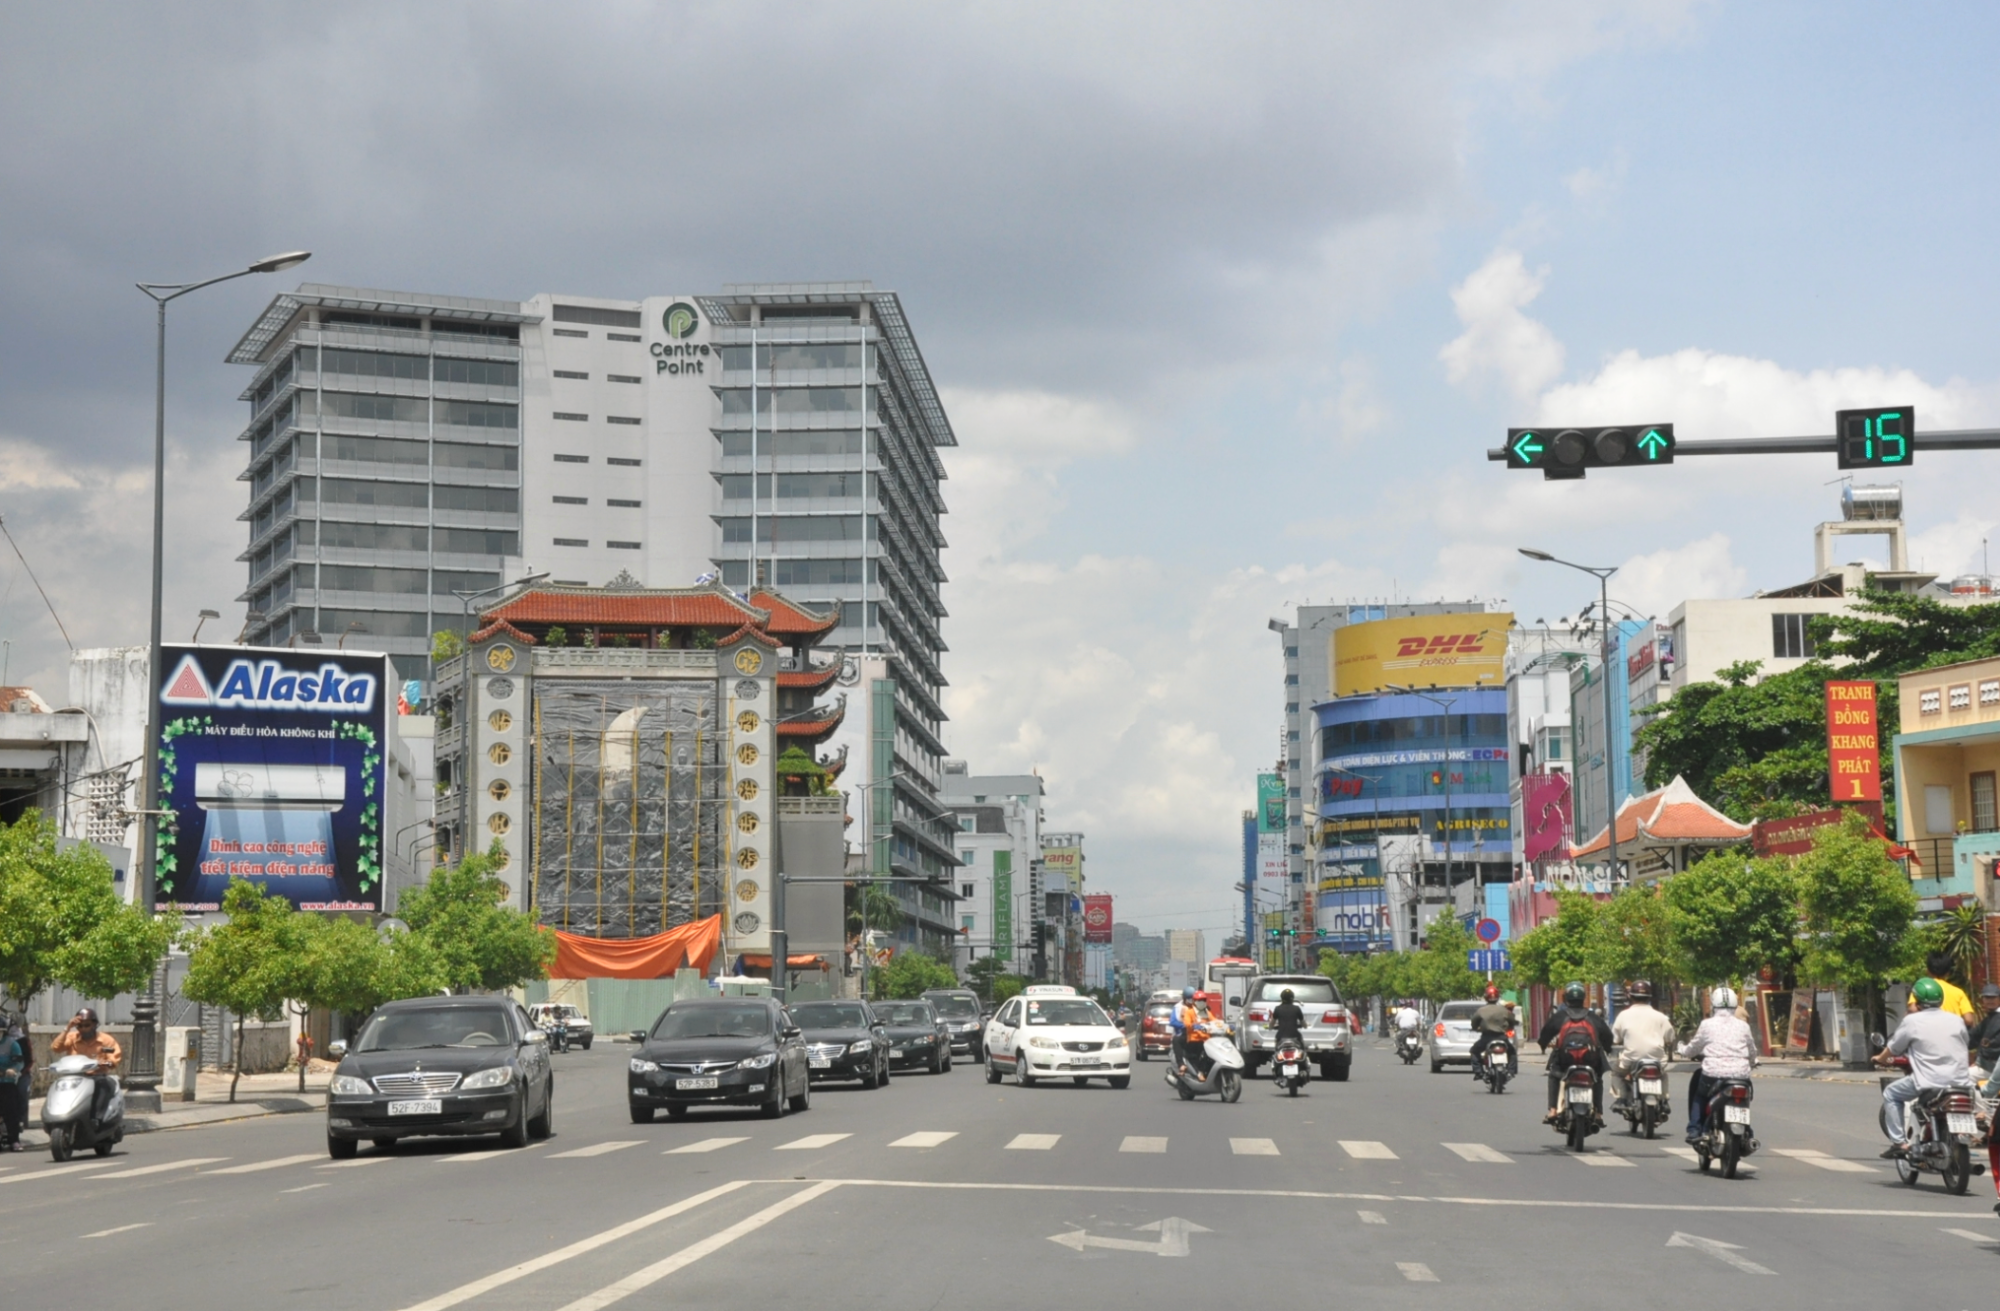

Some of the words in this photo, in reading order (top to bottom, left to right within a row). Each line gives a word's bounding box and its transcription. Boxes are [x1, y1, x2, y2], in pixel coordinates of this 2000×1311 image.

[650, 342, 710, 357] Centre
[657, 359, 703, 375] Point
[1865, 413, 1905, 462] 15
[1396, 634, 1484, 657] DHL
[1419, 657, 1459, 667] EXPRESS
[219, 663, 369, 704] Alaska
[1829, 686, 1872, 700] TRANH
[1834, 703, 1870, 725] ĐỒNG
[205, 724, 228, 735] MÁY
[256, 725, 278, 737] HÒA
[280, 727, 316, 738] KHÔNG
[318, 728, 335, 739] KHÍ
[1831, 735, 1875, 749] KHANG
[1837, 756, 1871, 773] PHÁT
[1850, 779, 1864, 798] 1
[1435, 818, 1509, 831] AGRISECO
[243, 842, 264, 853] cao
[265, 840, 295, 857] công
[296, 840, 327, 857] nghệ
[200, 857, 226, 875] tiết
[228, 860, 264, 878] kiệm
[266, 860, 297, 878] điện
[299, 860, 334, 878] năng
[300, 900, 375, 911] www.alaska.vn
